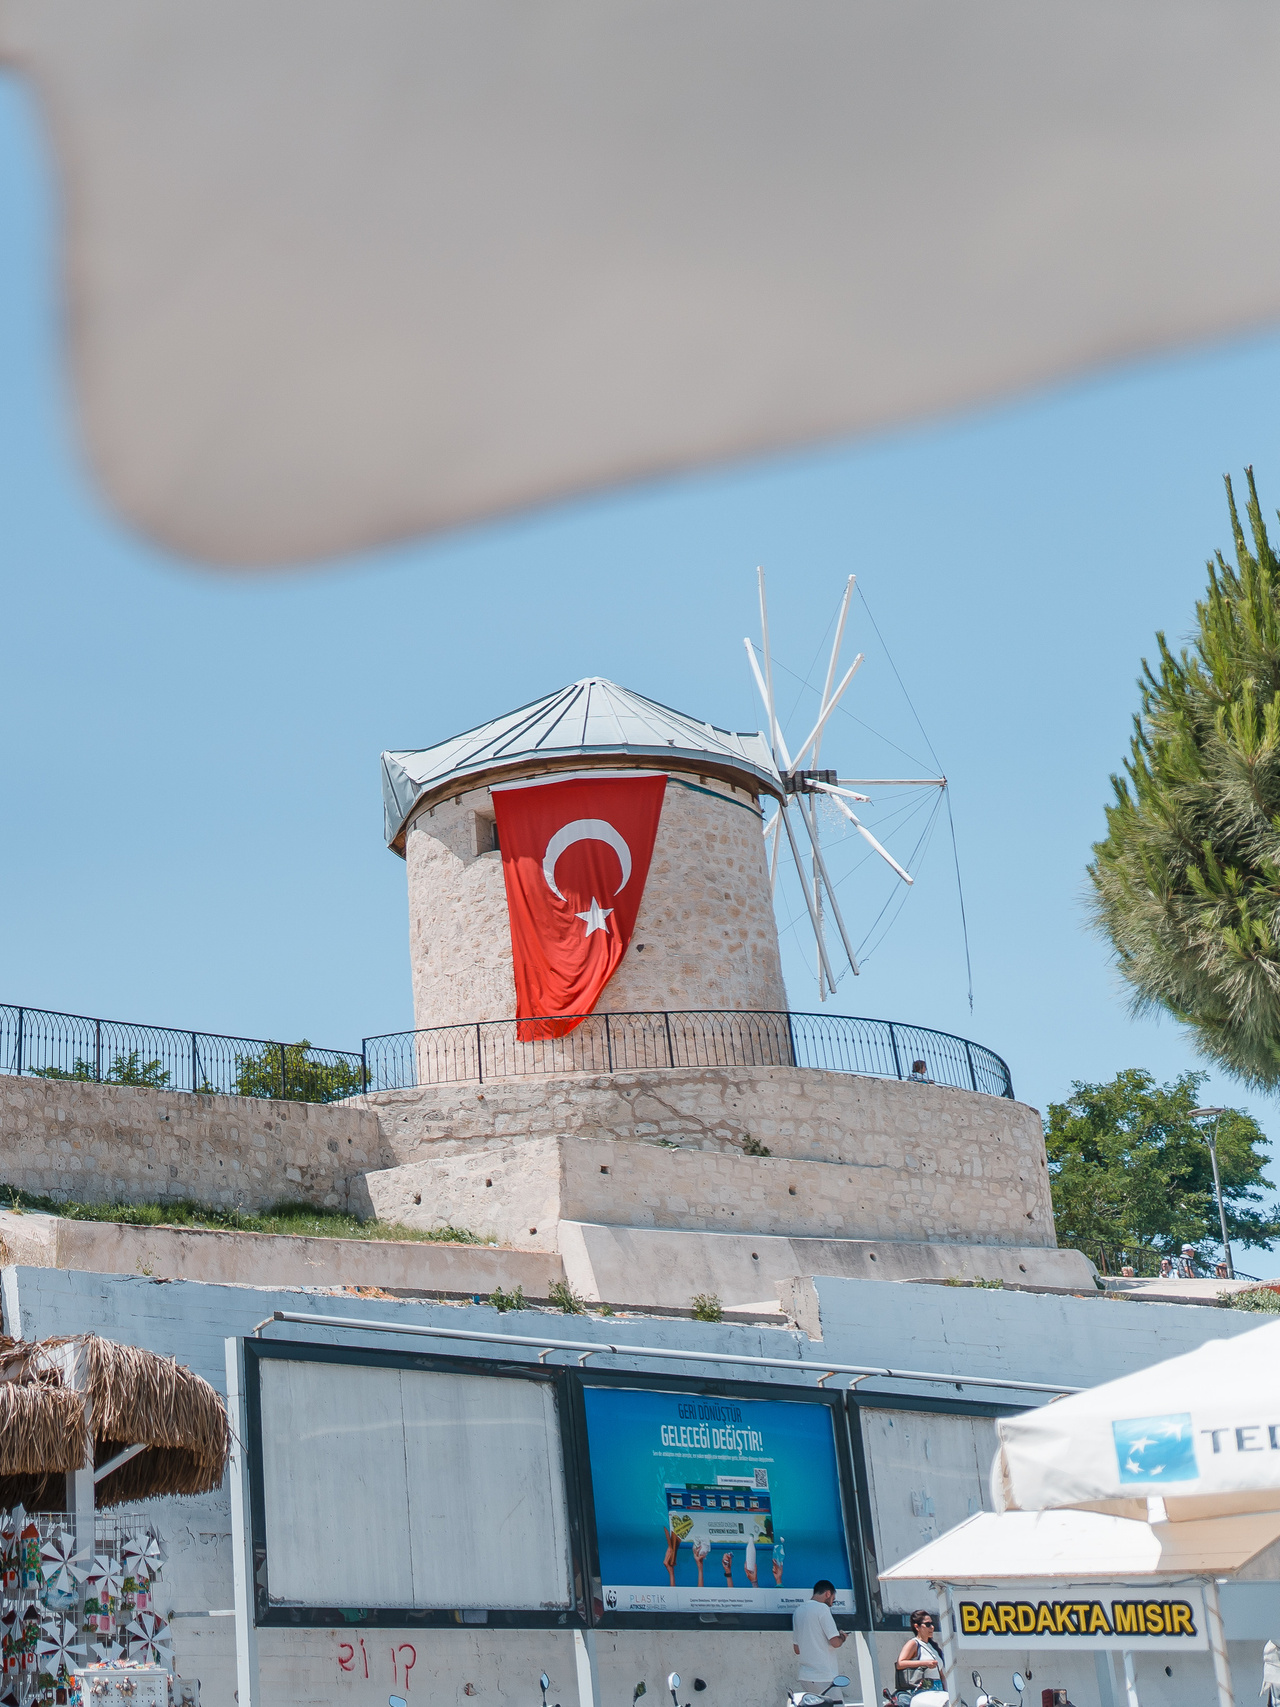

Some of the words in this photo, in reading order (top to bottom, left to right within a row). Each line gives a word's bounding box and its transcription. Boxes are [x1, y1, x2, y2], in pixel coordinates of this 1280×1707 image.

[678, 1400, 697, 1420] GERİ
[698, 1401, 742, 1425] DÖNÜŞTÜR
[661, 1423, 710, 1449] GELECEĞİ
[712, 1425, 763, 1455] DEĞİŞTİR!
[629, 1594, 666, 1603] PLASTİK
[960, 1602, 1111, 1636] BARDAKTA
[1112, 1601, 1197, 1636] MISIR
